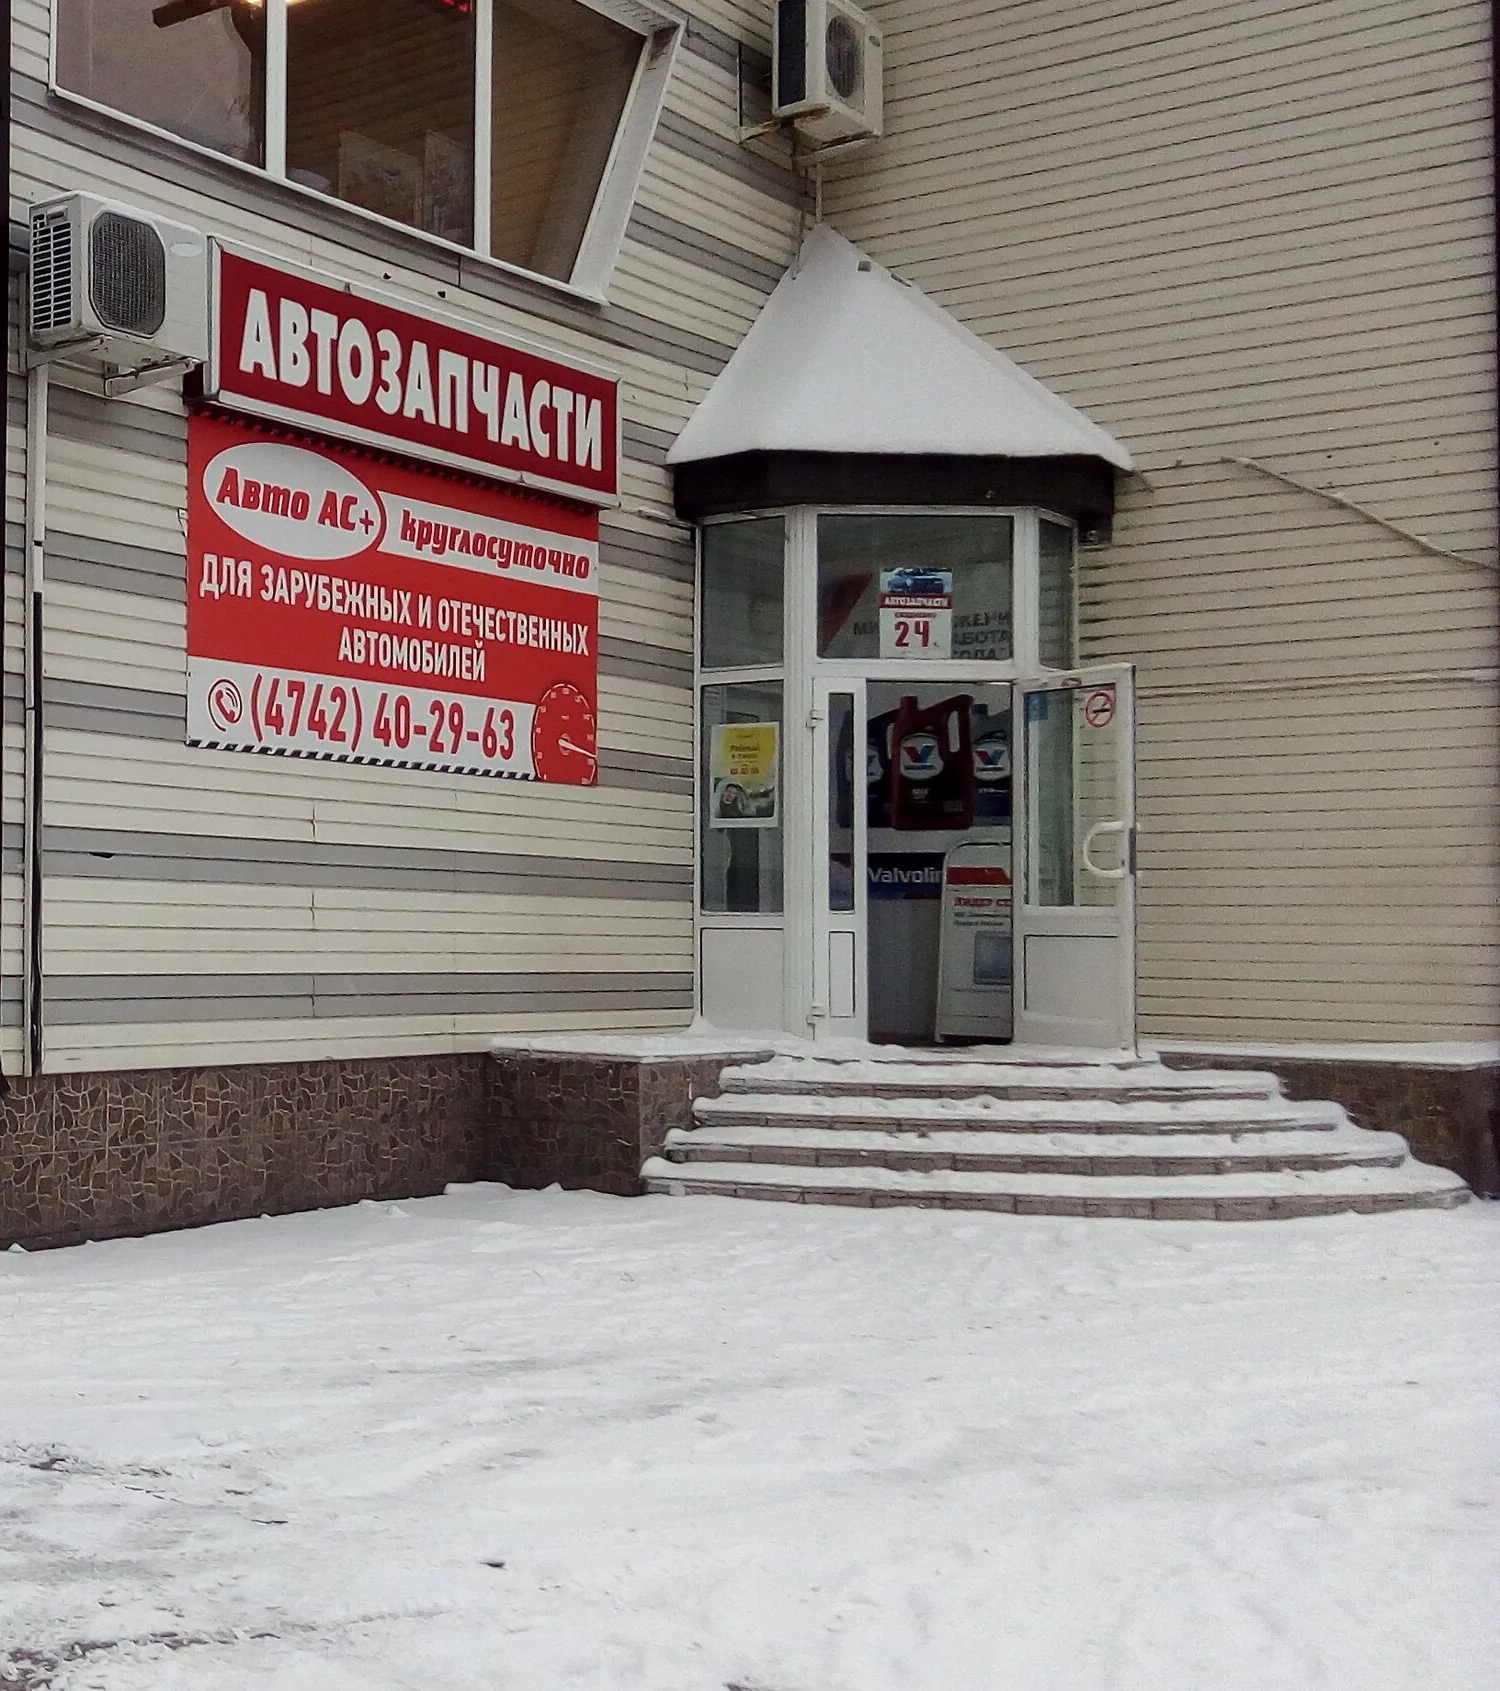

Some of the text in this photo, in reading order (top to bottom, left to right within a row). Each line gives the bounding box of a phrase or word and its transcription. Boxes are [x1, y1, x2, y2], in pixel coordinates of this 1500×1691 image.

[239, 288, 602, 471] АВТОЗАПЧАСТИ
[216, 467, 310, 521] Авто
[400, 509, 590, 579] круглосуточно
[200, 553, 589, 656] ДЛЯ ЗАРУБЕЖНЫХ И ОТЕЧЕСТВЕННЫХ
[338, 627, 485, 683] АВТОМОБИЛЕЙ
[250, 673, 362, 751] (4742)
[373, 693, 516, 760] 40-29-63
